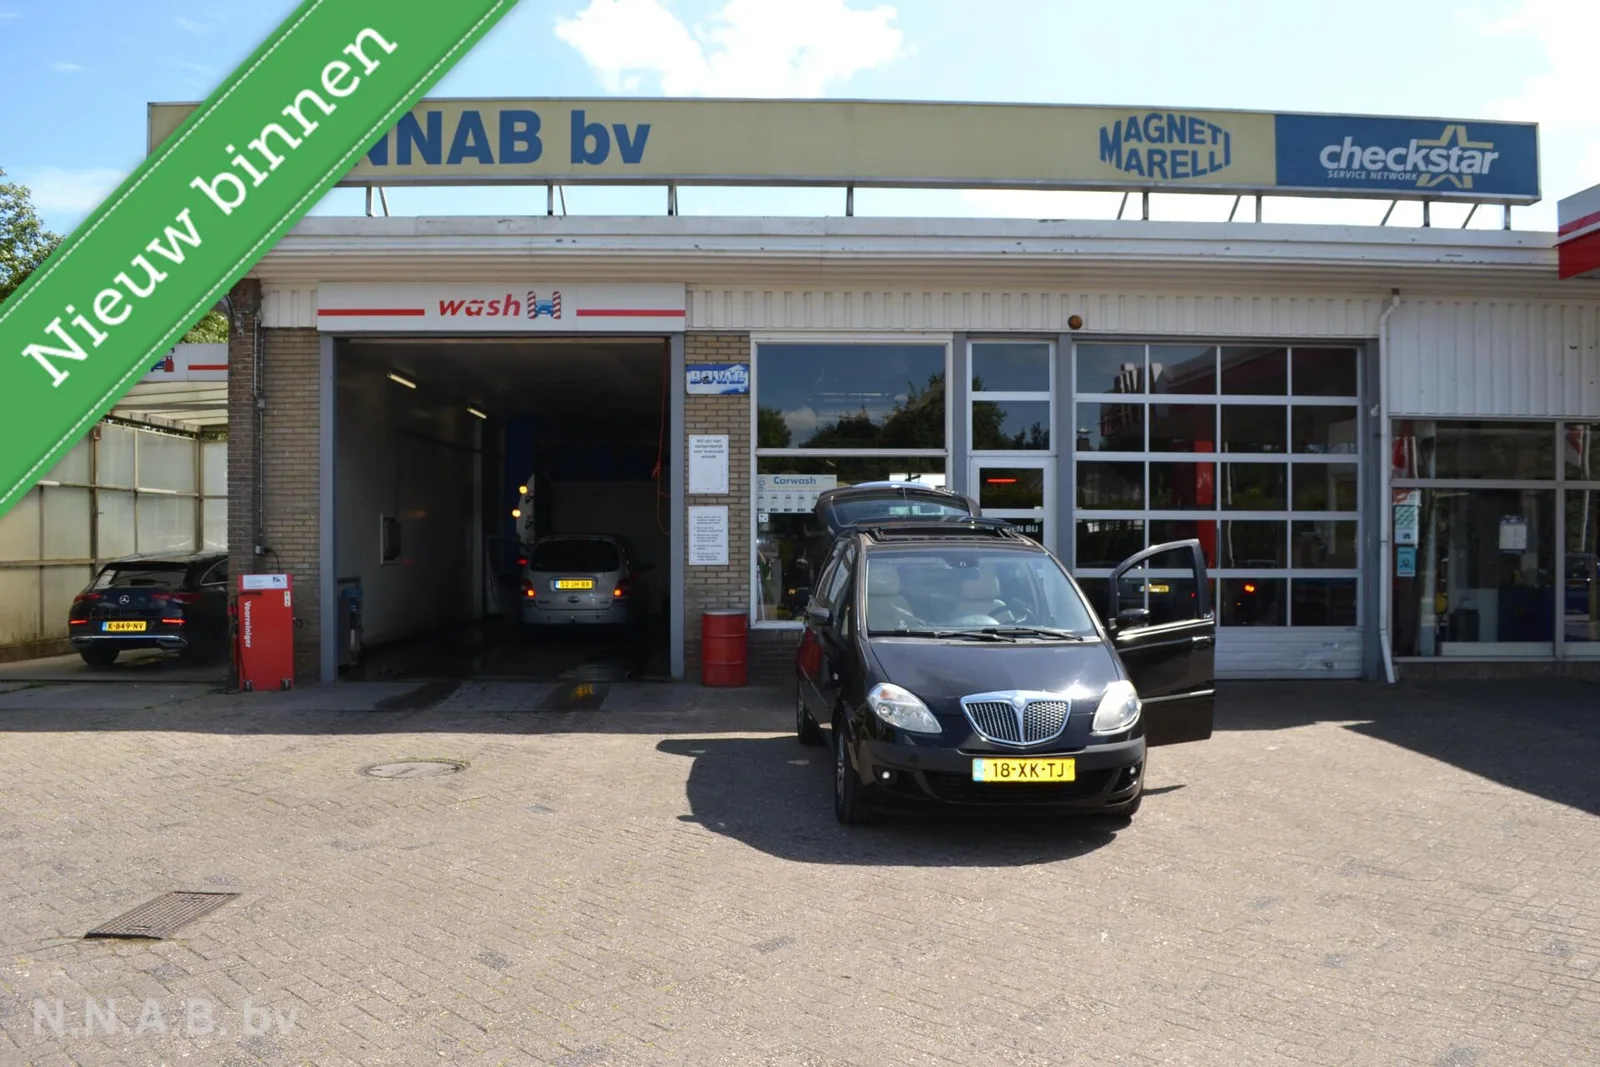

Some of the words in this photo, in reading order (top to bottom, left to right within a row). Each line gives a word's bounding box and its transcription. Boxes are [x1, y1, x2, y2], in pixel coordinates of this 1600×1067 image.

[570, 110, 651, 165] bv
[1100, 112, 1230, 158] MAGNETI
[1100, 136, 1230, 179] MARELLI
[1319, 136, 1499, 175] checkstar
[1327, 170, 1366, 180] SERVICE
[1370, 172, 1417, 181] NETWORK
[439, 293, 521, 317] wash
[690, 370, 746, 384] BOVAG
[773, 476, 817, 485] Carwash
[108, 622, 144, 630] K-849-NV
[244, 600, 252, 649] Voorreiniger
[993, 762, 1065, 778] 18-XK-TJ
